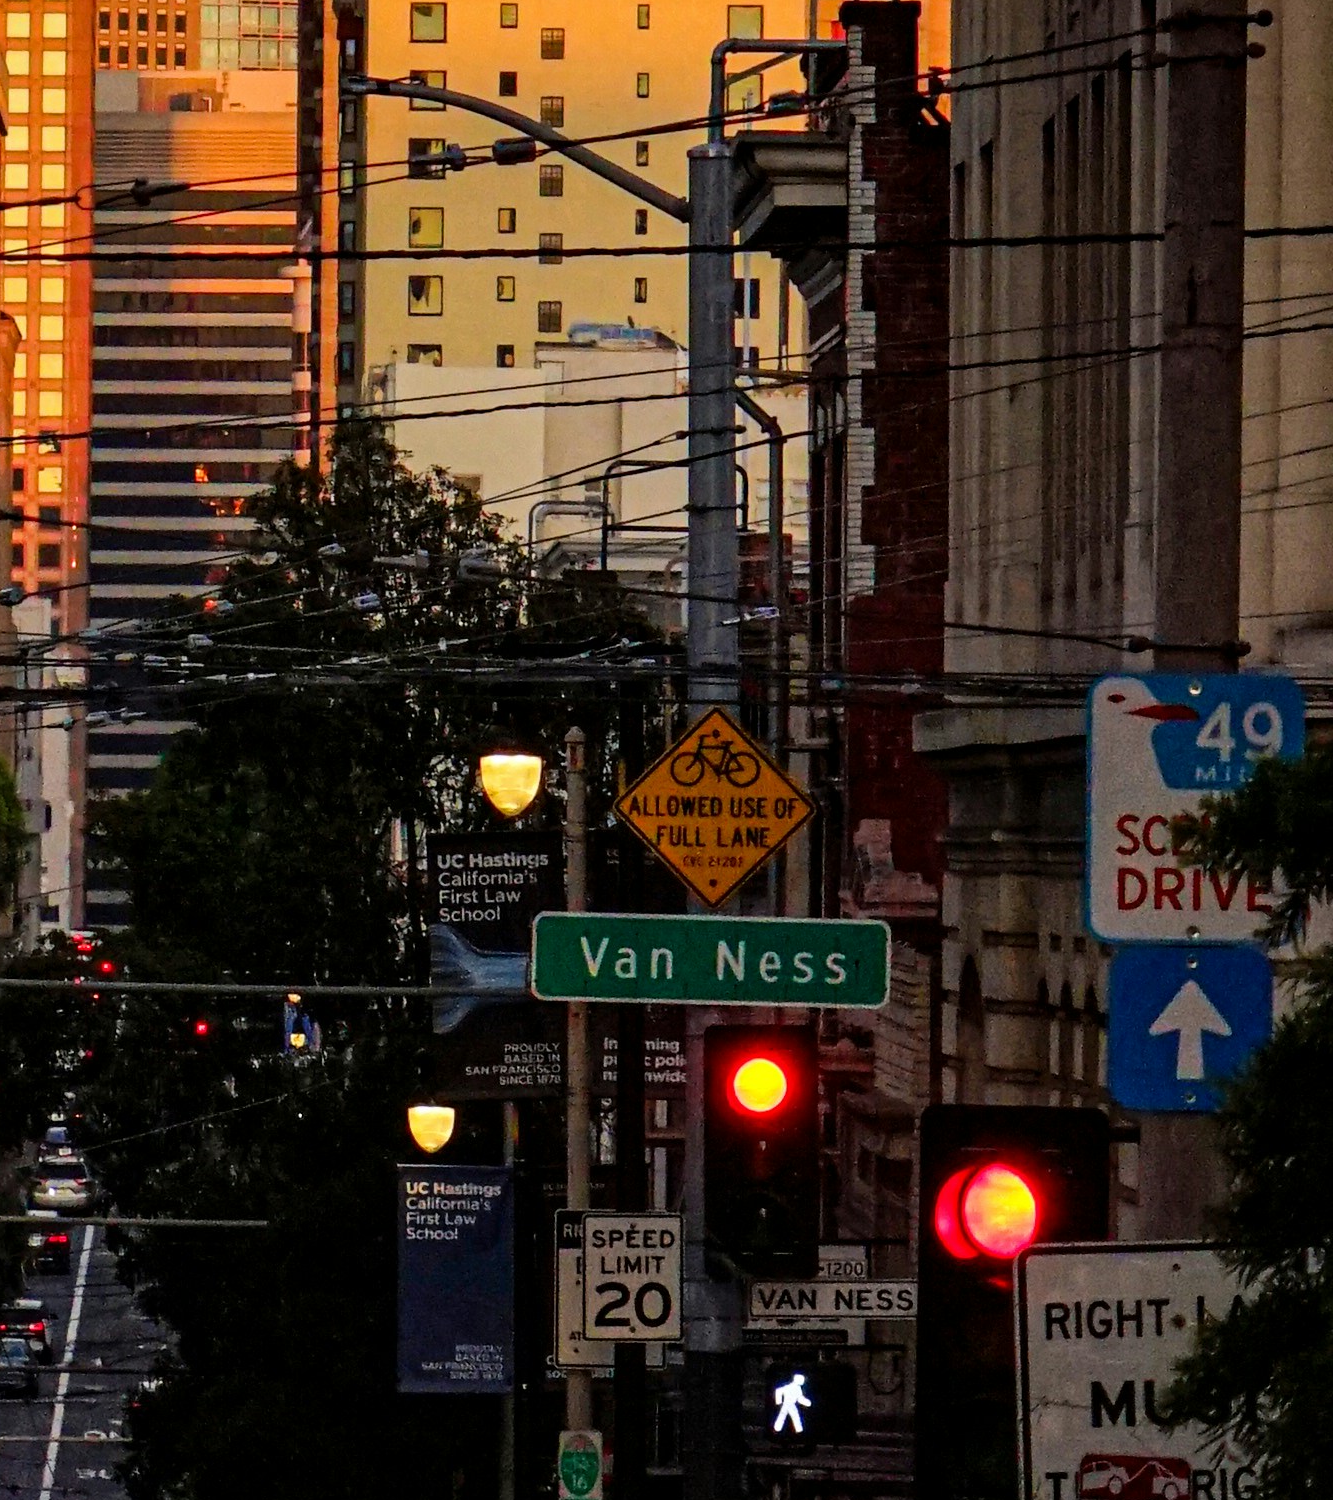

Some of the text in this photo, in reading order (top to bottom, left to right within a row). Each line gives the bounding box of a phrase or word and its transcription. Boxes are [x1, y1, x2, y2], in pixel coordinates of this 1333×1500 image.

[1196, 702, 1283, 762] 49
[1195, 766, 1254, 783] MIL
[629, 796, 799, 819] ALLOWED USE OF
[656, 825, 771, 848] FULL LANE
[436, 852, 549, 869] UC Hastings
[438, 870, 538, 887] California's
[438, 889, 522, 905] First Law
[1117, 867, 1273, 912] DRIVE
[438, 906, 501, 922] School
[581, 936, 849, 984] Van Ness
[504, 1043, 560, 1053] PROUDLY
[504, 1053, 561, 1063] BASED IN
[465, 1064, 561, 1076] SAN FRANCISCO
[499, 1075, 534, 1086] SINCE
[406, 1181, 502, 1198] UC Hastings
[406, 1197, 492, 1211] California's
[406, 1213, 477, 1226] First Law
[406, 1227, 459, 1240] School
[592, 1229, 676, 1249] SPEED
[601, 1256, 665, 1275] LIMIT
[827, 1262, 864, 1276] 1200
[595, 1281, 672, 1328] 20
[758, 1288, 914, 1311] VAN NESS
[1045, 1298, 1171, 1340] RIGHT
